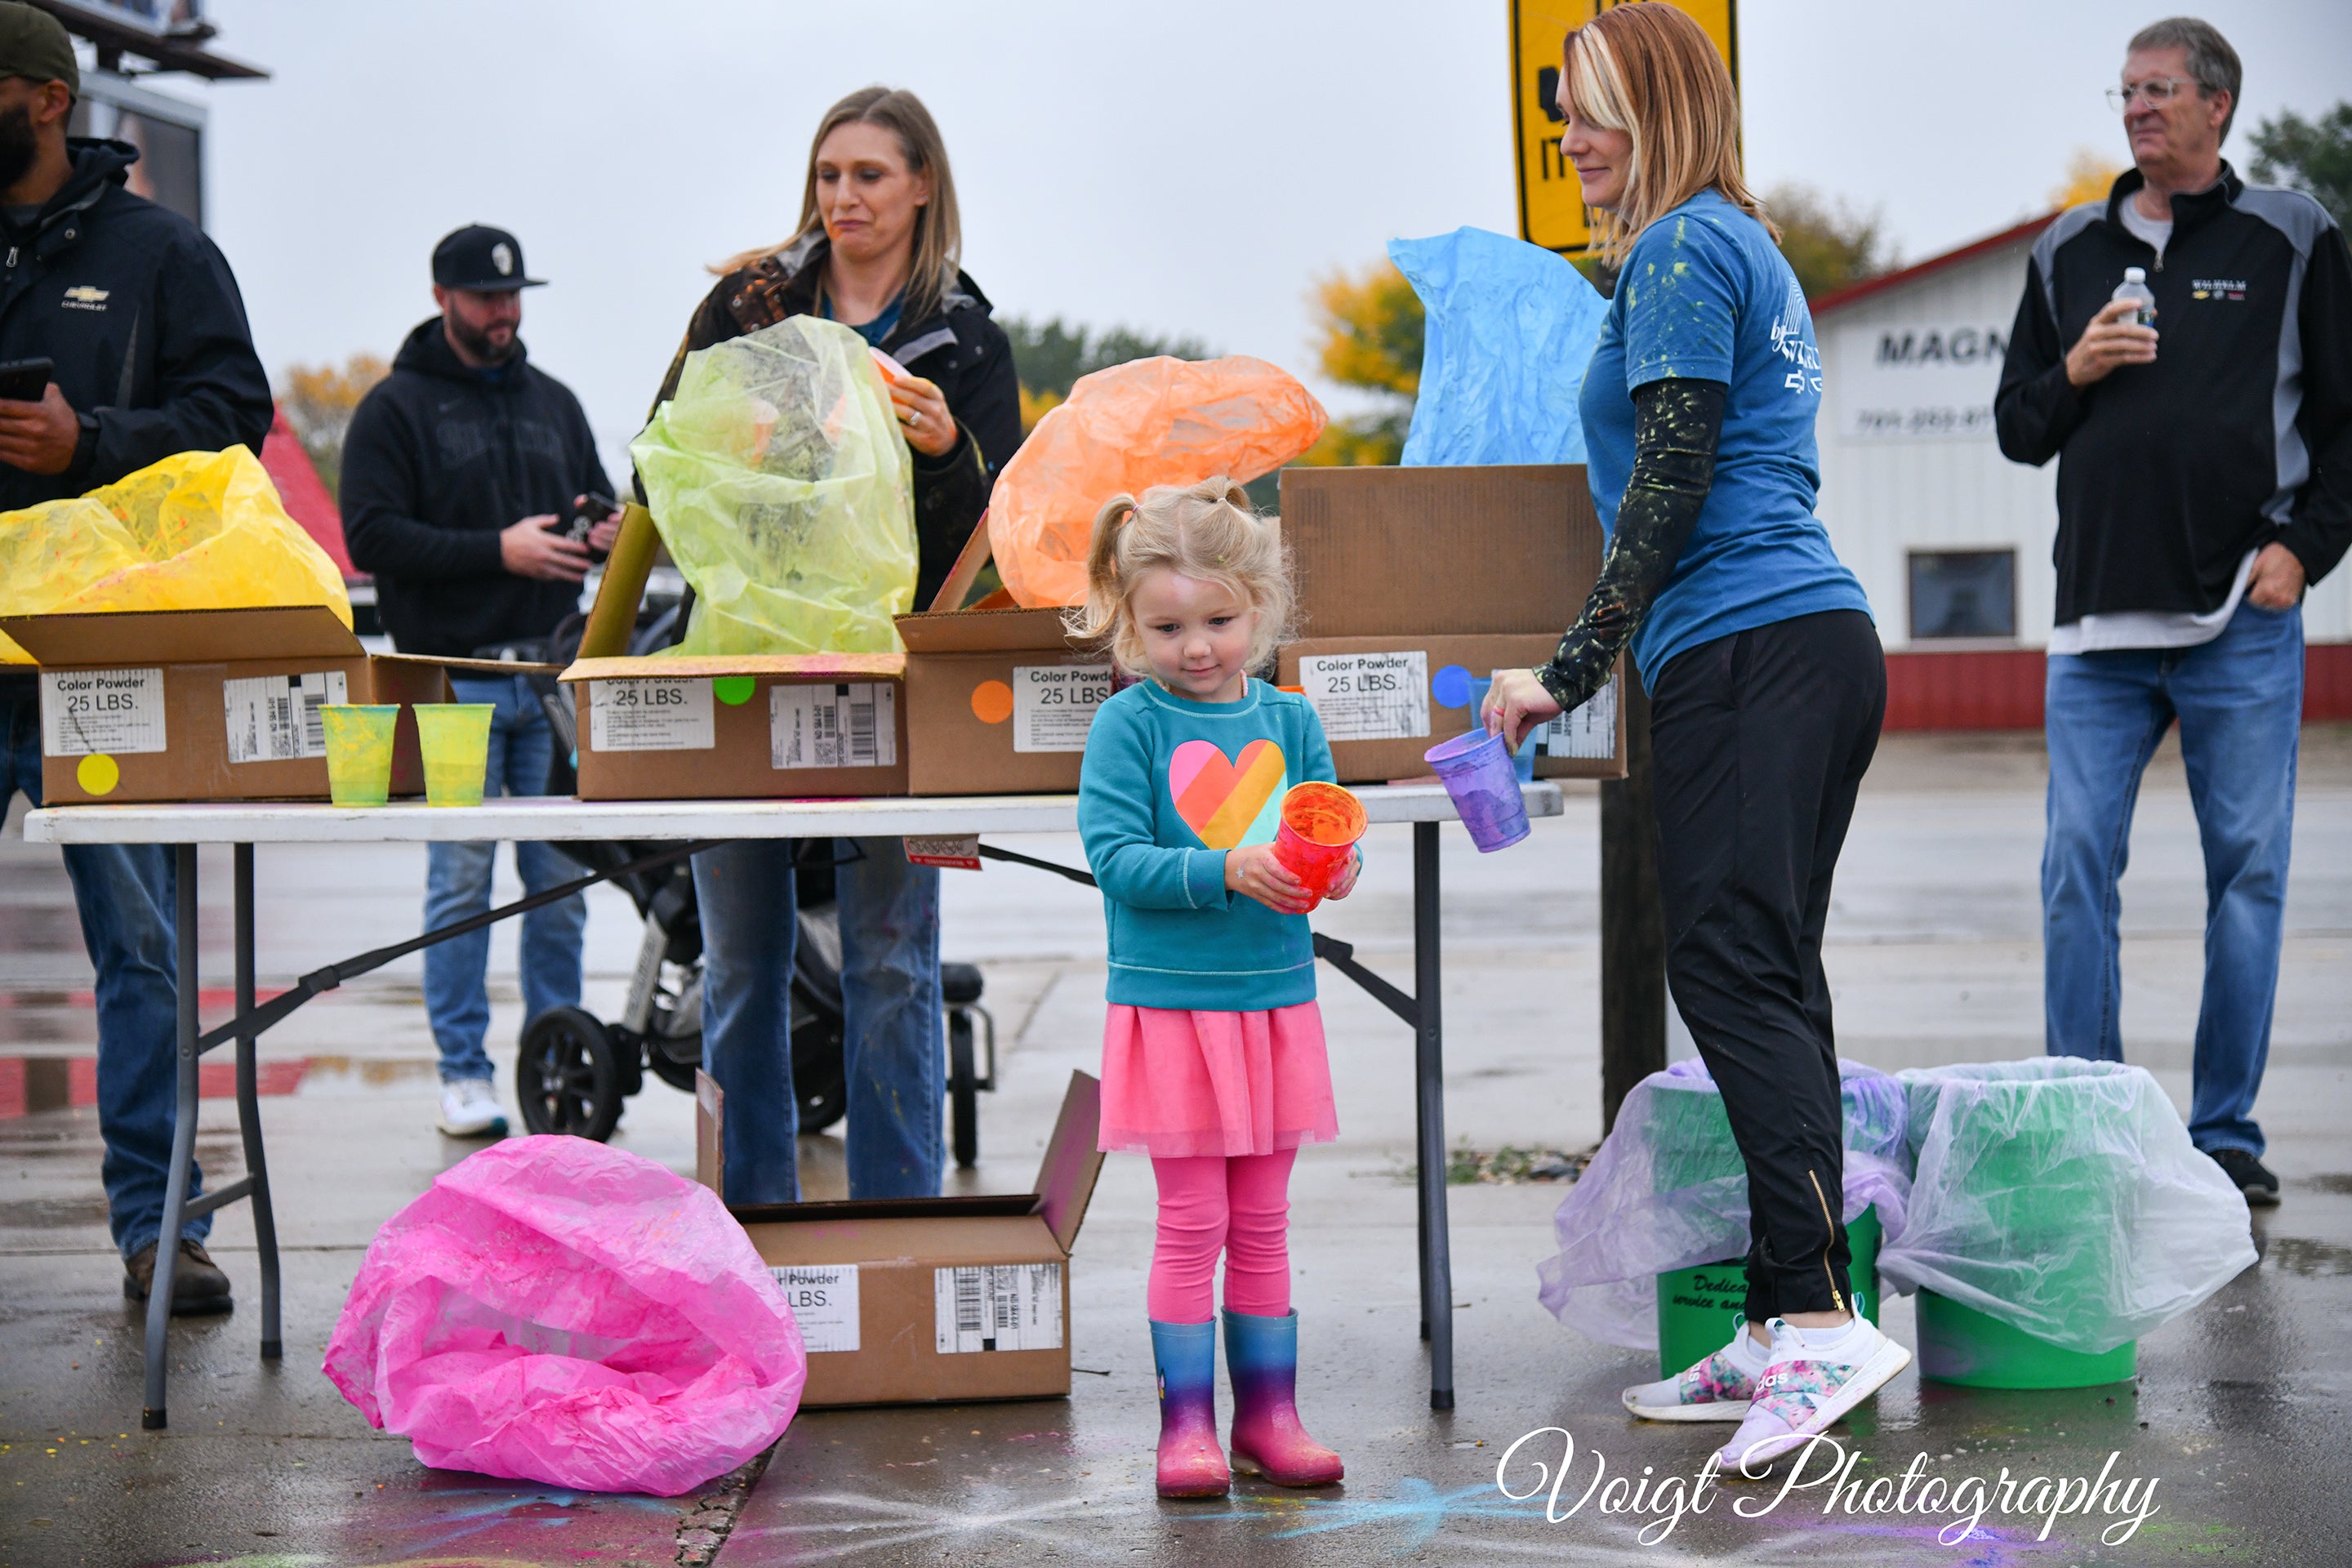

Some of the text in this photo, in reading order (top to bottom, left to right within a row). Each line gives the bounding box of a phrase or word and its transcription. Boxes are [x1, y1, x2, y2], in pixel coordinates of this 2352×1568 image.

[1770, 315, 1787, 353] by
[1316, 657, 1408, 671] Color Powder
[57, 677, 145, 691] Color Powder
[1030, 670, 1067, 682] Color
[1328, 674, 1402, 693] 25 LBS.
[68, 693, 139, 712] 25 LBS.
[616, 688, 688, 706] 25 LBS.
[1040, 687, 1108, 704] 25 LBS
[789, 1274, 840, 1285] Powder
[788, 1290, 832, 1307] LBS.
